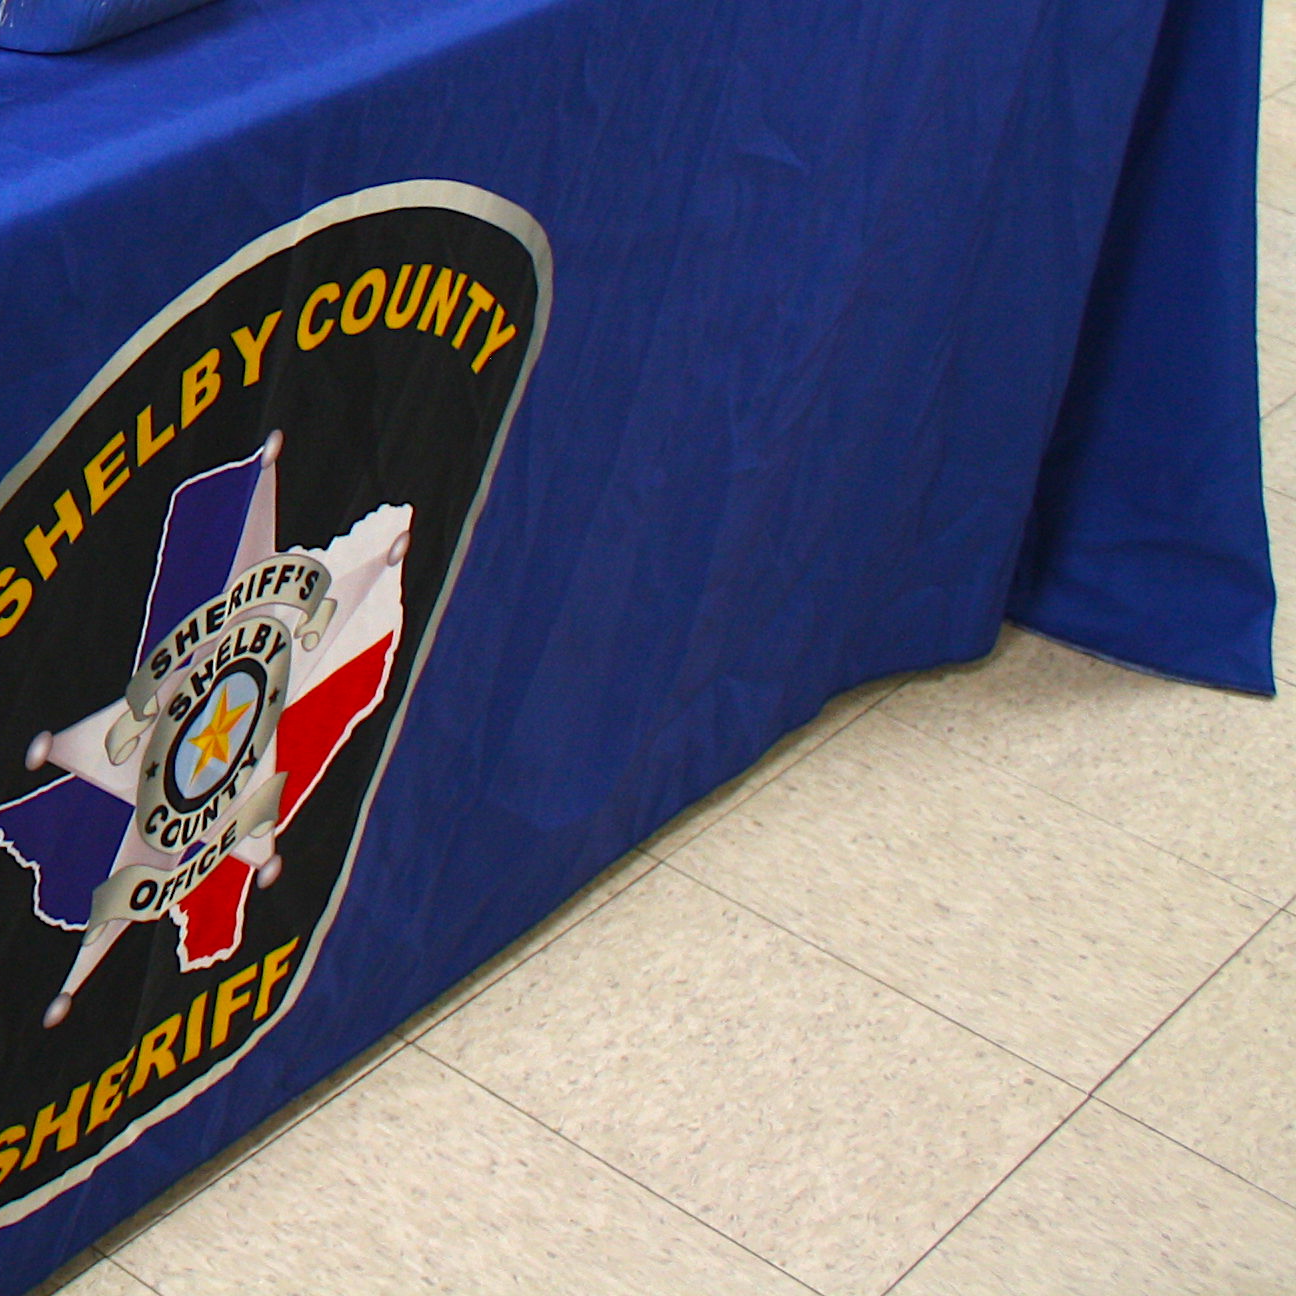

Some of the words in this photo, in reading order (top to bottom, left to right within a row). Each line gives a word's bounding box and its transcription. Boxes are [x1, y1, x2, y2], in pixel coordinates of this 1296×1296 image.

[296, 263, 517, 375] COUNTY
[151, 563, 320, 680] SHERIFF'S
[168, 622, 287, 723] SHELBY
[144, 744, 258, 849] COUNTY
[129, 820, 240, 912] OFFICE
